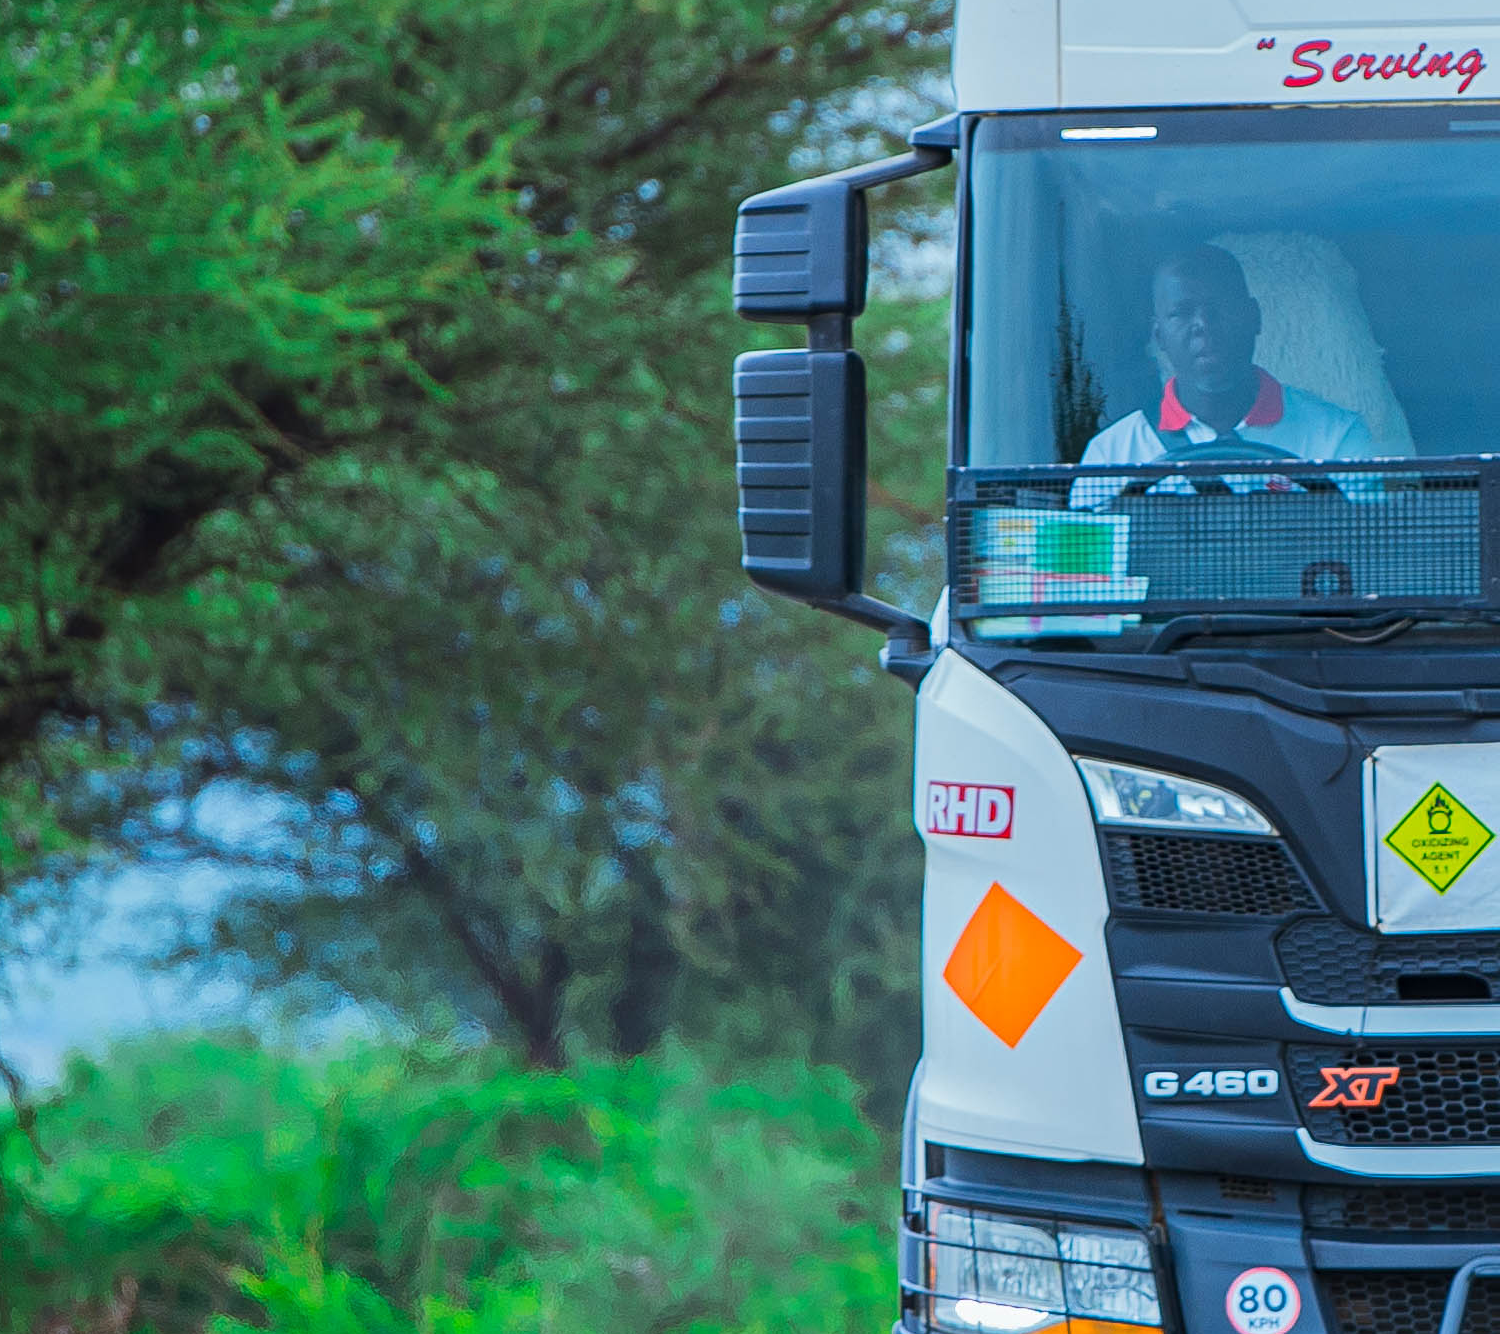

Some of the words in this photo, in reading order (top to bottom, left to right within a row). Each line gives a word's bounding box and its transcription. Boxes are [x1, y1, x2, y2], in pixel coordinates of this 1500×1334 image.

[927, 784, 1012, 835] RHD
[1144, 1072, 1179, 1097] G
[1184, 1070, 1279, 1096] 460
[1308, 1067, 1400, 1107] XT
[1239, 1284, 1287, 1313] 80
[1249, 1317, 1280, 1328] KPH
